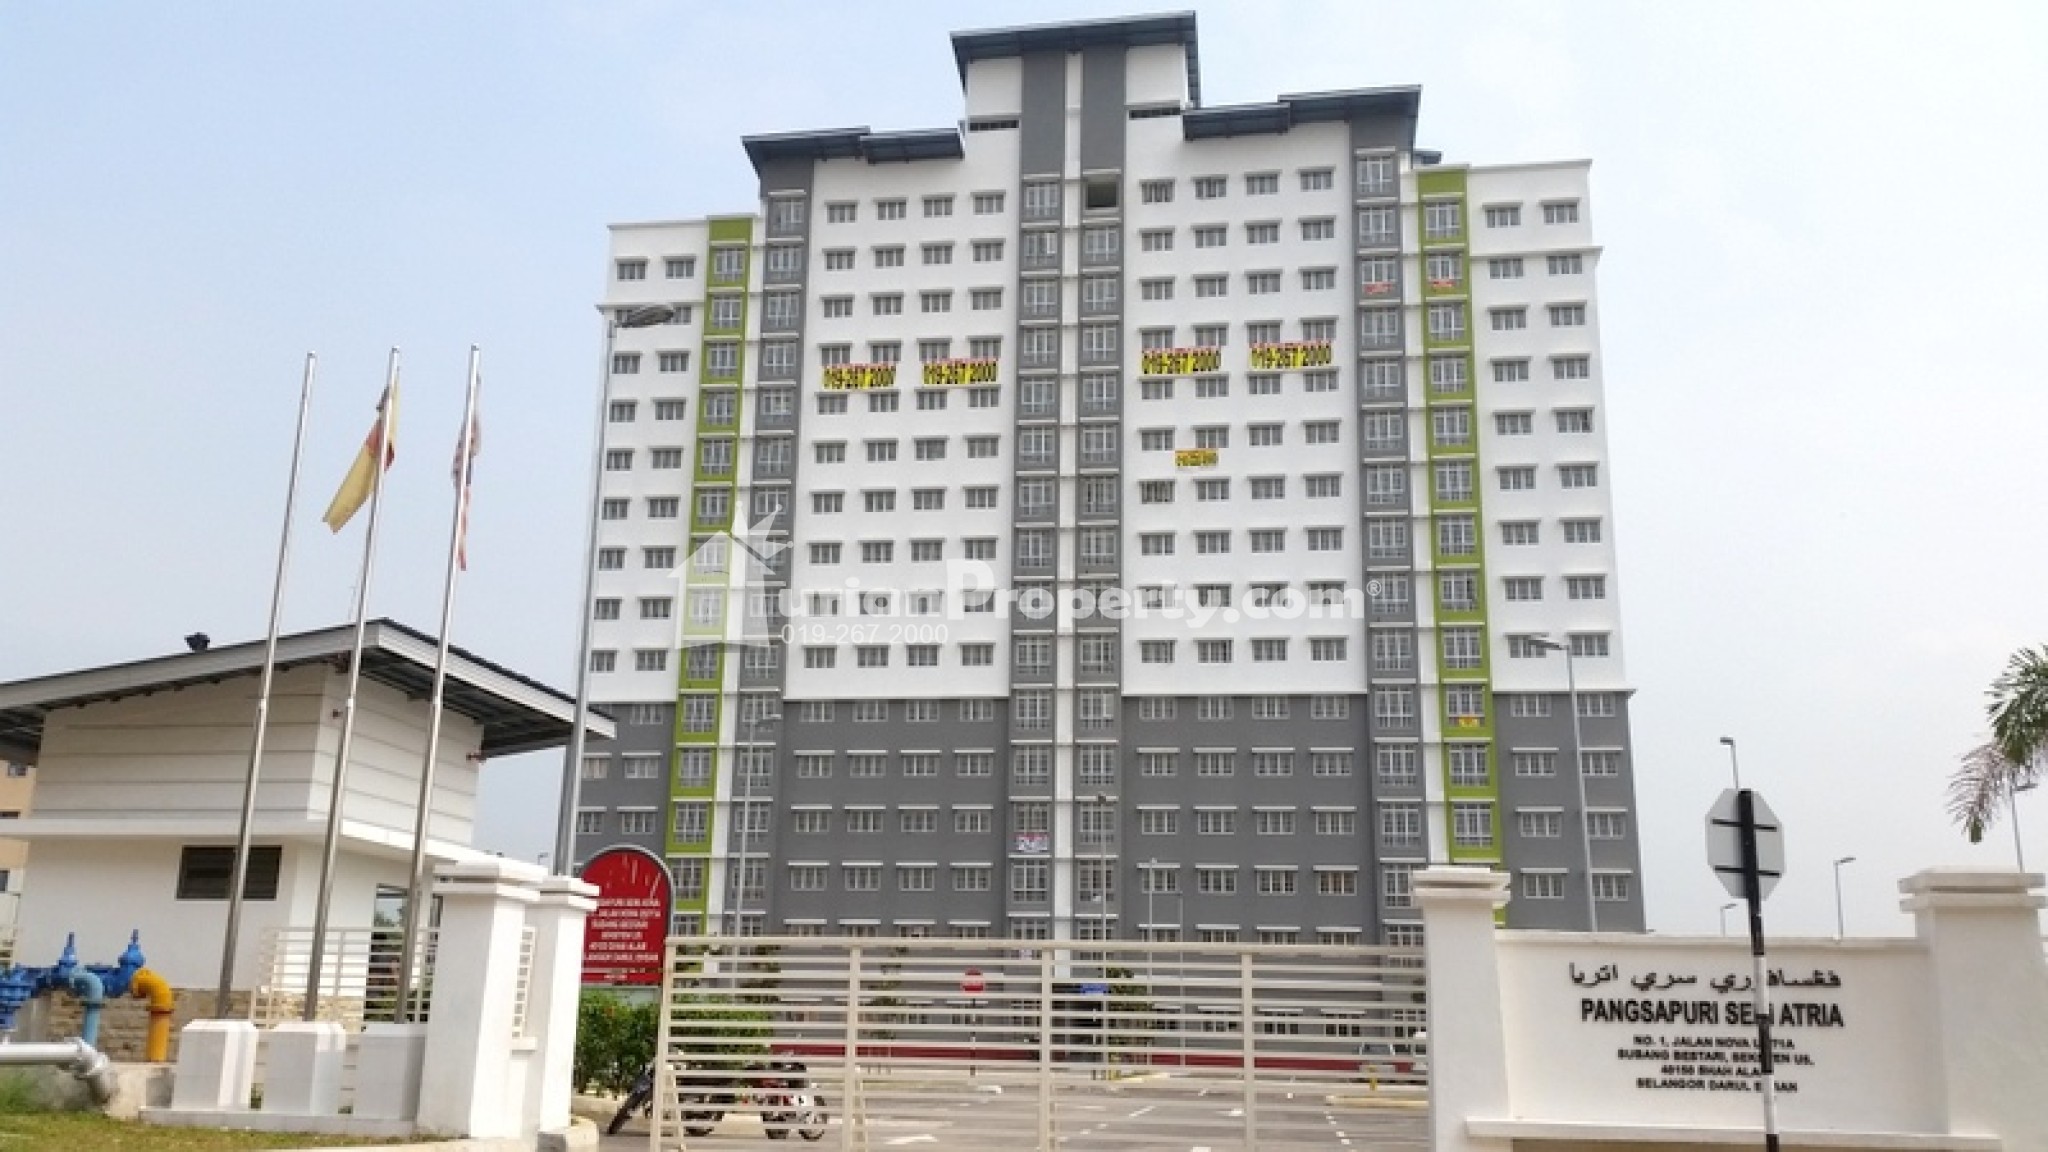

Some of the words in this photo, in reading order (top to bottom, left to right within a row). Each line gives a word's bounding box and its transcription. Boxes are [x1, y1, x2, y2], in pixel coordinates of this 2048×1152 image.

[1581, 998, 1718, 1025] PANGSAPURI
[1725, 1001, 1774, 1027] SEI
[1779, 1003, 1844, 1028] ATRIA
[1633, 1034, 1656, 1047] NO.
[1672, 1036, 1713, 1048] JALAN
[1715, 1037, 1750, 1048] NOVA
[1618, 1048, 1669, 1061] SUBANG
[1735, 1066, 1766, 1078] ALA
[1636, 1078, 1705, 1090] SELANGOR
[1709, 1080, 1751, 1092] DARUL
